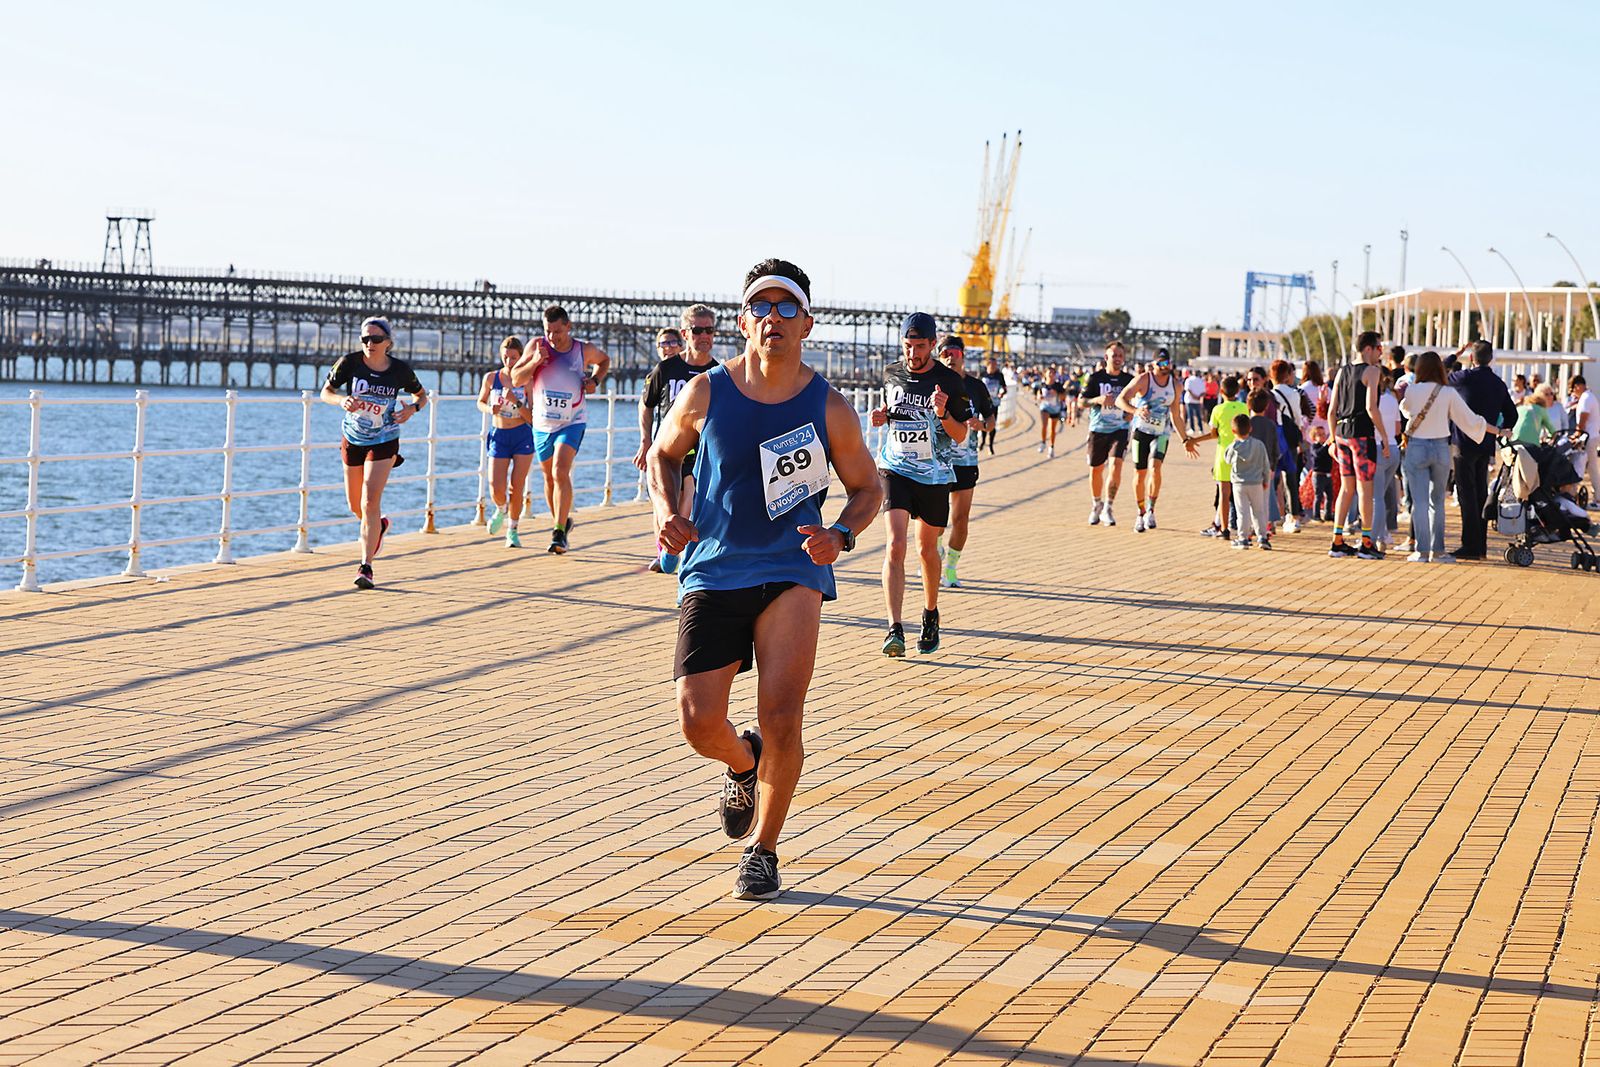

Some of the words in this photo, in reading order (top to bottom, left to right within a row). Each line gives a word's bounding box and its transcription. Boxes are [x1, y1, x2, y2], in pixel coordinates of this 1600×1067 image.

[352, 376, 368, 394] 10
[368, 385, 395, 396] HUELVA
[546, 398, 567, 408] 315
[902, 392, 932, 408] HUELVA
[358, 401, 381, 415] 479
[774, 438, 798, 450] AVATEL
[892, 430, 928, 444] 1024
